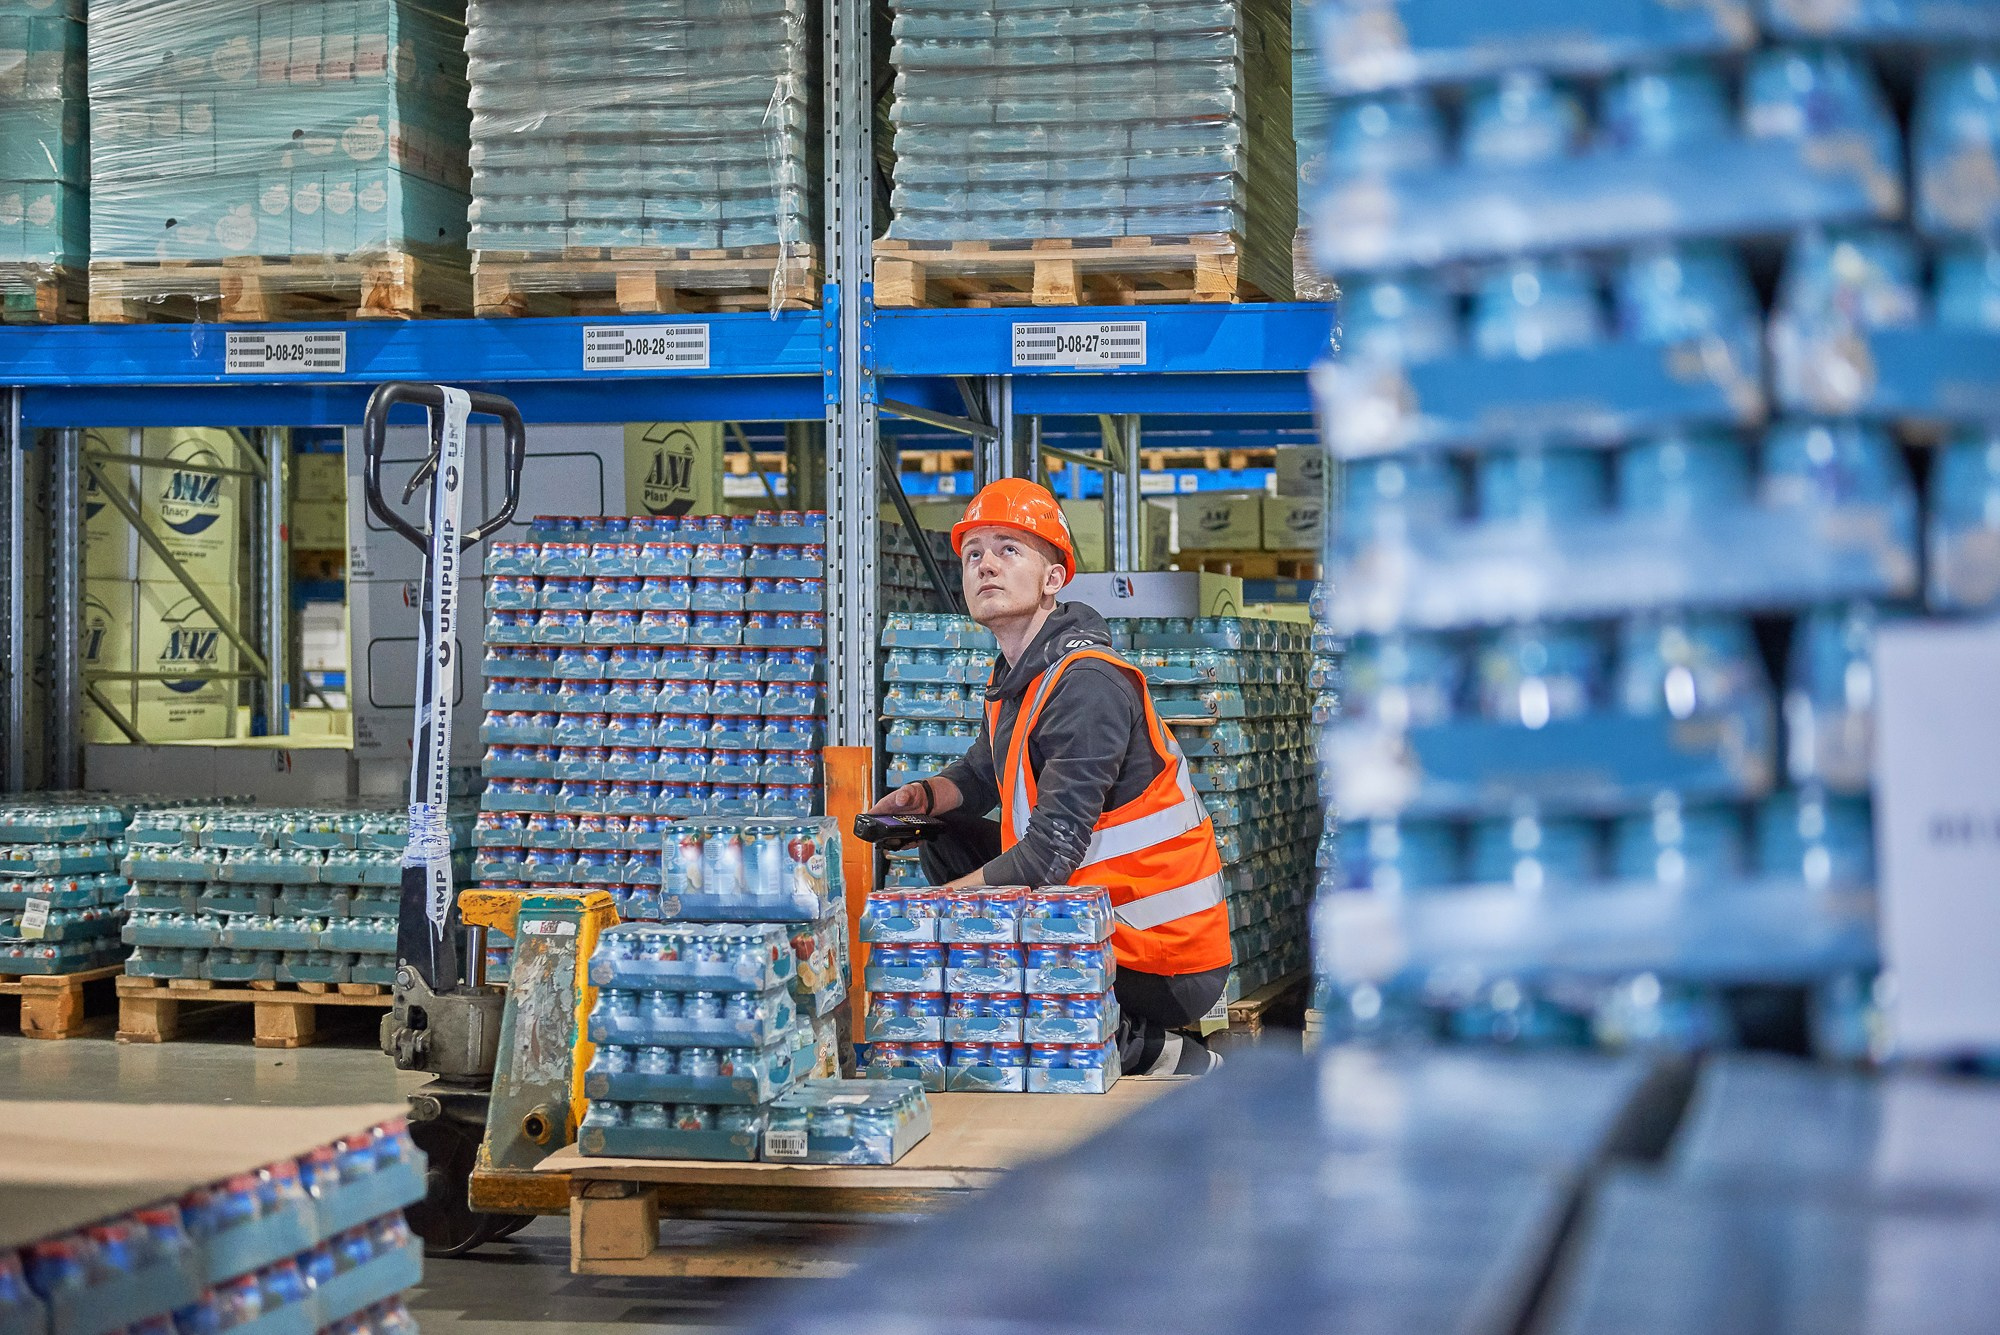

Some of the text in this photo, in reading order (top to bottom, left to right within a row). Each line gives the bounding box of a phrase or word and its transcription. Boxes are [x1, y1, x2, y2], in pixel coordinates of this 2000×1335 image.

[665, 328, 675, 336] 60
[1016, 327, 1026, 335] 30
[1100, 325, 1110, 333] 60
[229, 336, 238, 344] 30
[304, 335, 313, 343] 60
[1100, 338, 1110, 346] 50
[625, 338, 665, 355] D-08-28
[666, 341, 675, 349] 50
[1016, 340, 1026, 348] 20
[1056, 335, 1099, 352] D-08-27
[229, 348, 238, 356] 20
[265, 344, 304, 361] D-08-29
[304, 347, 314, 355] 50
[1099, 351, 1109, 359] 40
[665, 353, 674, 361] 40
[440, 518, 454, 633] UNIPUMP
[1212, 742, 1220, 755] 8
[1211, 776, 1221, 790] 7
[1210, 811, 1219, 824] 6
